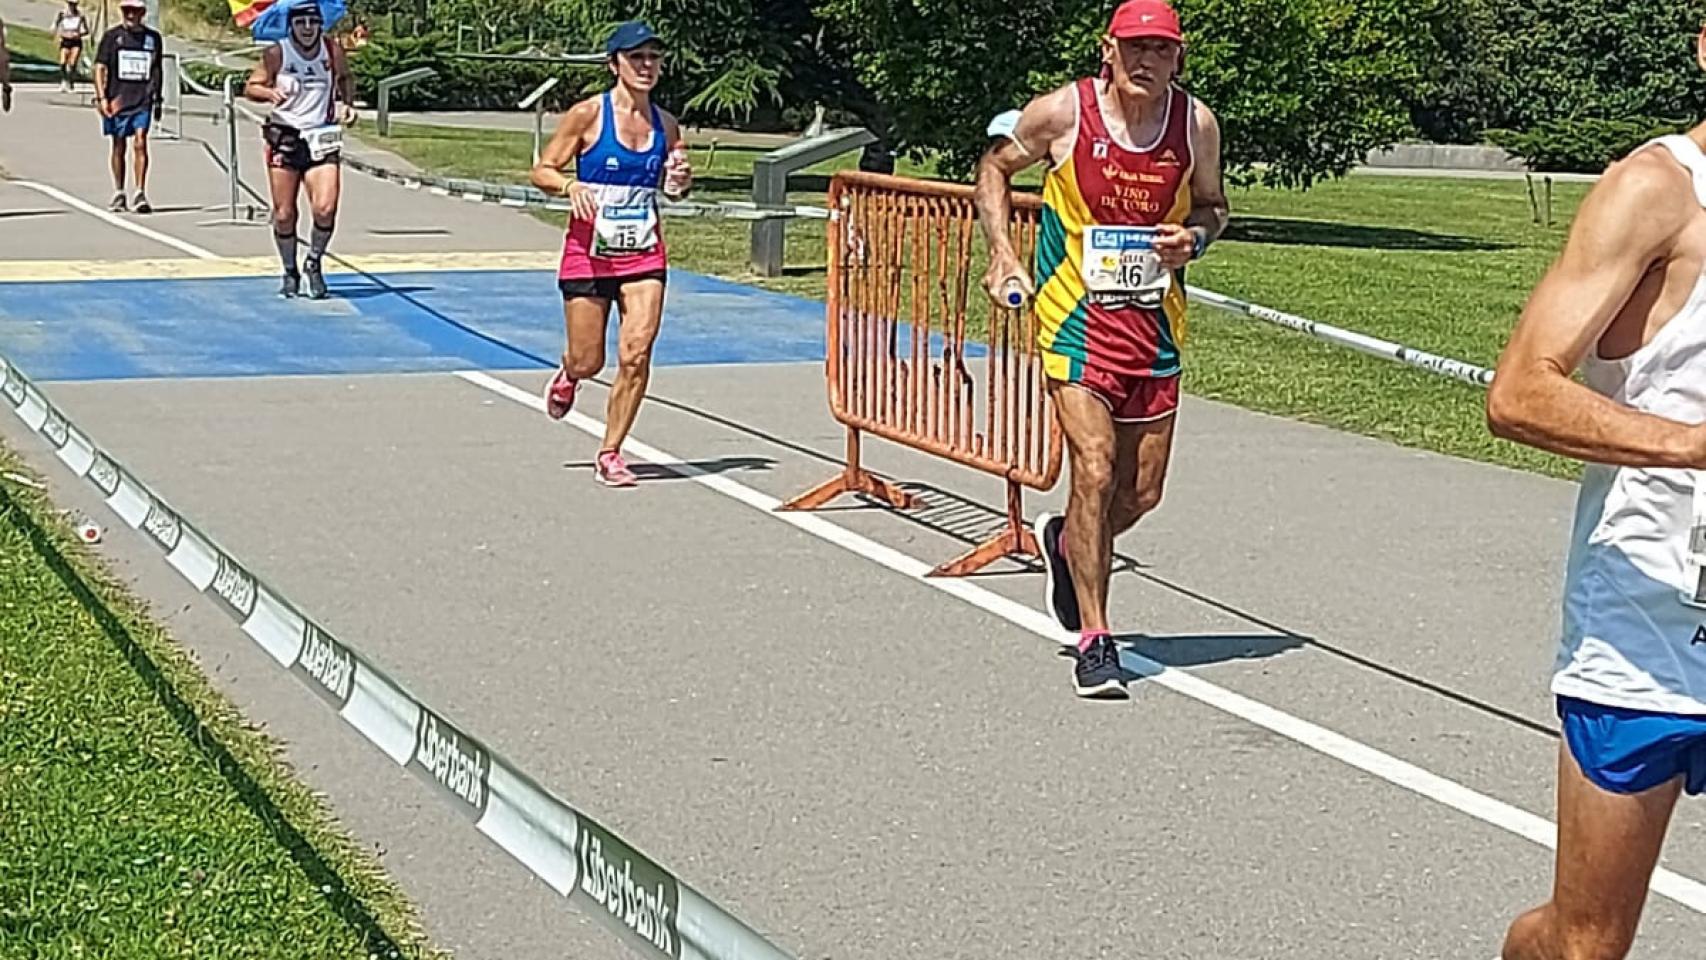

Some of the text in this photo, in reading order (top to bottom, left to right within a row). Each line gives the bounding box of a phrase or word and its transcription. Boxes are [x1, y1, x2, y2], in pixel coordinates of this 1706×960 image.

[1101, 195, 1117, 208] DE
[1114, 184, 1150, 200] VINO
[418, 711, 484, 808] Liberbank
[581, 829, 673, 955] Liberbank
